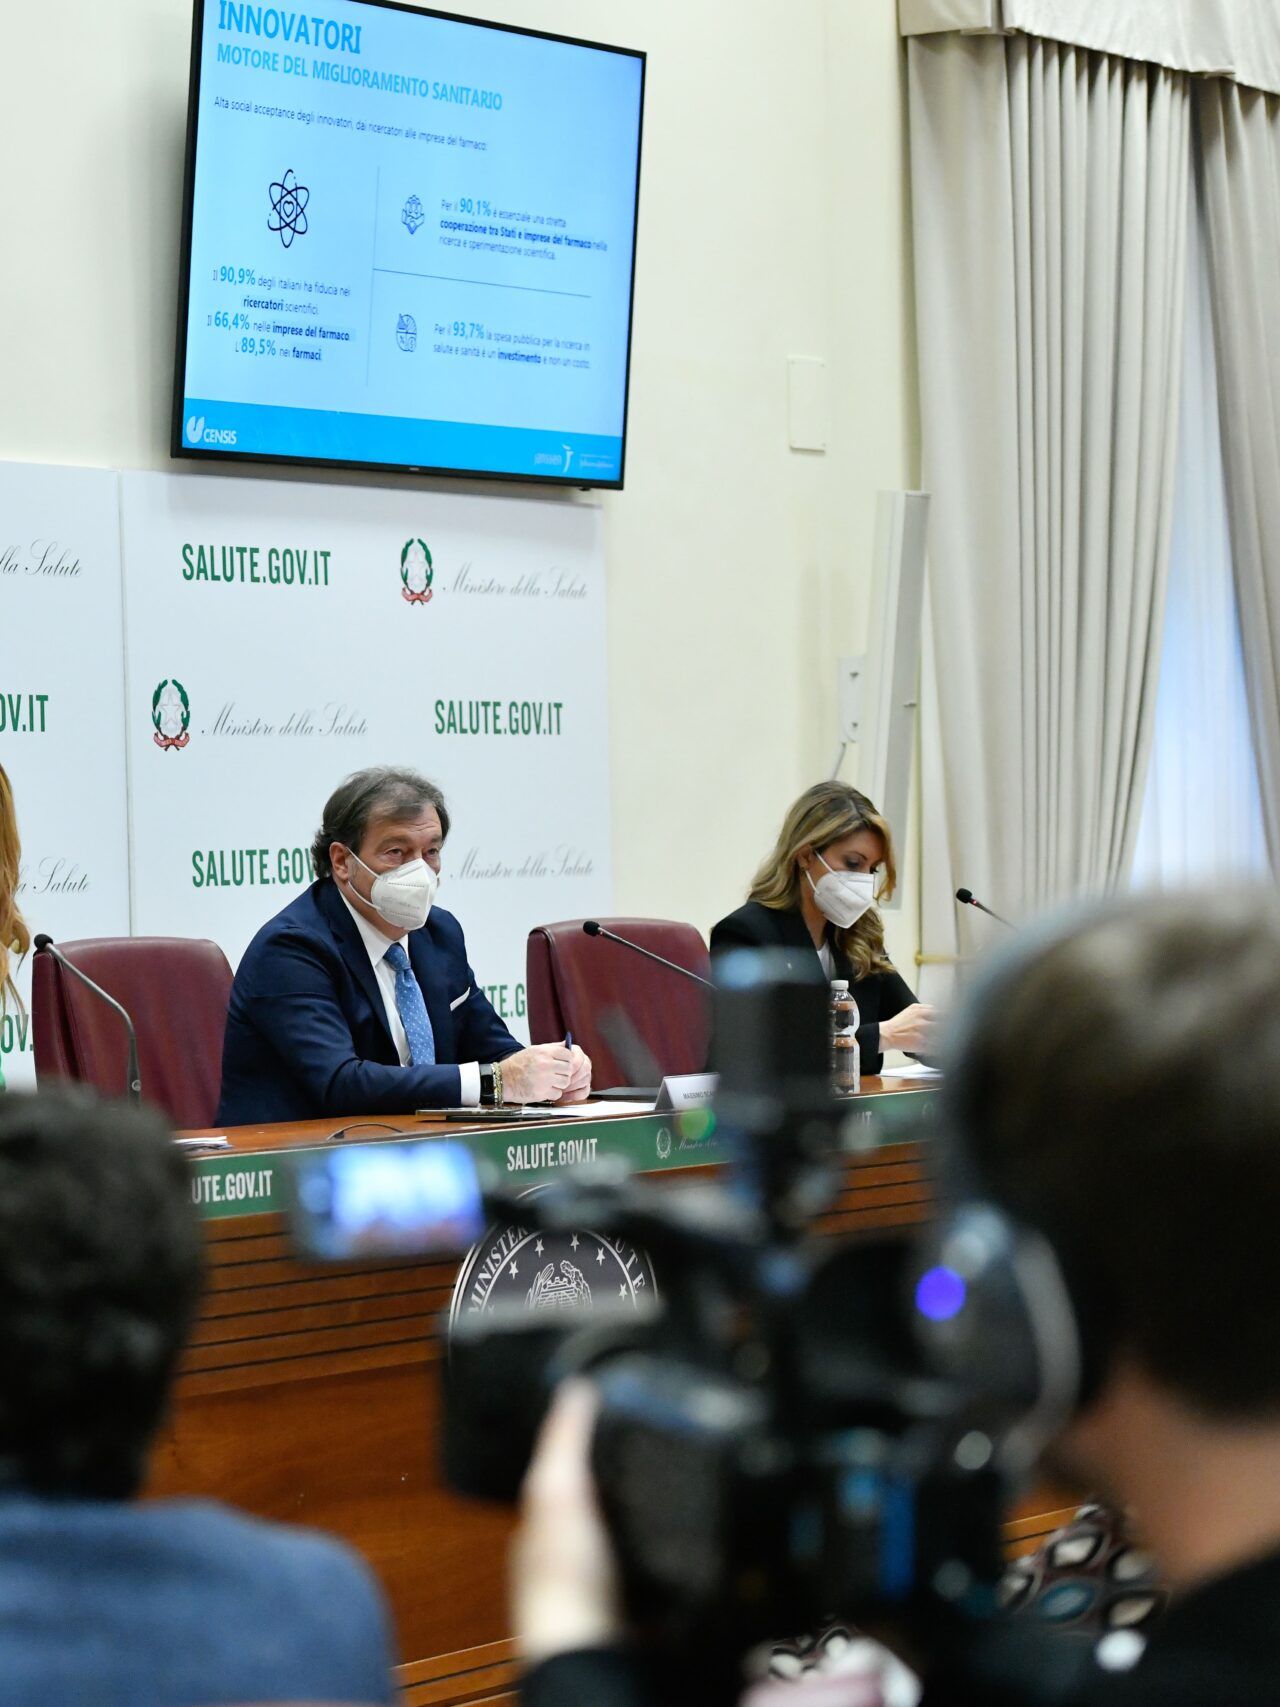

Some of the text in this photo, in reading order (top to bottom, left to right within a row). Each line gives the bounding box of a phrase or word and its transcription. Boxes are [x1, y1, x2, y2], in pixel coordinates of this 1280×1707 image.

[218, 0, 362, 54] INNOVATORI
[217, 43, 503, 111] MOTORE DEL MIGLIORAMENTO SANITARIO
[214, 96, 229, 109] Alta
[231, 99, 252, 112] social
[254, 103, 295, 119] acceptance
[297, 109, 314, 125] degli
[356, 119, 366, 131] dai
[419, 130, 445, 145] imprese
[447, 133, 457, 146] del
[441, 199, 452, 211] Per
[460, 197, 492, 216] 90,1%
[440, 219, 487, 235] cooperazione
[489, 225, 499, 236] tra
[500, 226, 517, 238] Stati
[524, 230, 551, 245] imprese
[552, 234, 563, 246] del
[564, 236, 592, 249] farmaco
[220, 265, 256, 286] 90,9%
[258, 276, 276, 291] degli
[304, 280, 312, 293] ha
[314, 281, 338, 296] fiducia
[243, 295, 283, 311] ricercatori
[214, 311, 250, 331] 66,4%
[253, 320, 271, 333] nelle
[272, 321, 303, 337] imprese
[305, 325, 317, 338] del
[319, 327, 350, 342] farmaco
[434, 323, 445, 335] Per
[453, 321, 485, 340] 93,7%
[433, 343, 453, 355] salute
[497, 347, 541, 364] investimento
[203, 428, 237, 445] CENSIS
[24, 538, 83, 578] Salute
[182, 543, 332, 586] SALUTE.GOV.IT
[442, 561, 588, 598] Ministero della Salute
[201, 701, 369, 738] Ministero della Salute
[434, 700, 563, 736] SALUTE.GOV.IT
[32, 855, 90, 896] Salute
[192, 847, 315, 888] SALUTE.GOV
[450, 844, 595, 881] Ministero della Salute
[507, 1138, 598, 1172] SALUTE.GOV.IT
[191, 1170, 273, 1204] UTE.GOV.IT
